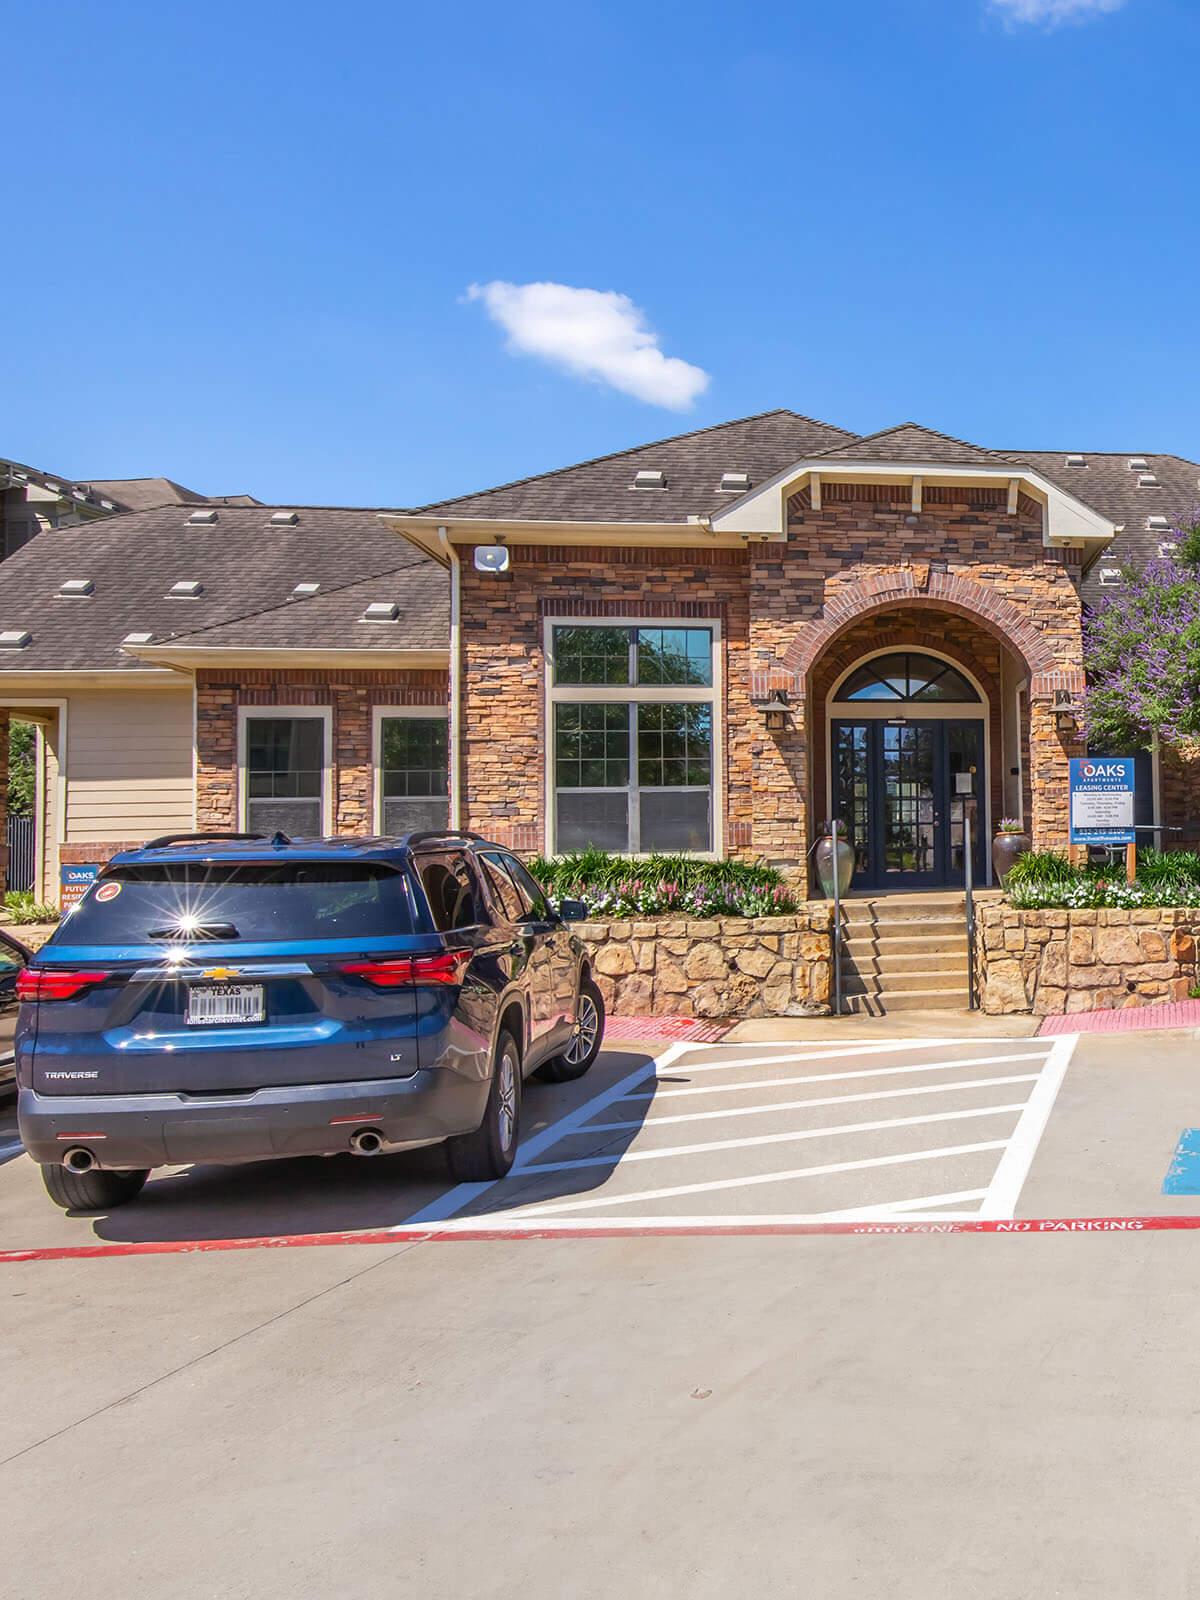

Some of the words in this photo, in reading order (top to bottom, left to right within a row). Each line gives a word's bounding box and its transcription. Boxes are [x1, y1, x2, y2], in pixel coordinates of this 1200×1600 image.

[1084, 764, 1125, 777] OAKS
[212, 988, 241, 996] TEXAS
[390, 1053, 402, 1061] LT
[44, 1071, 99, 1079] TRAVERSE
[996, 1222, 1030, 1231] NO
[1039, 1220, 1144, 1231] PARKING
